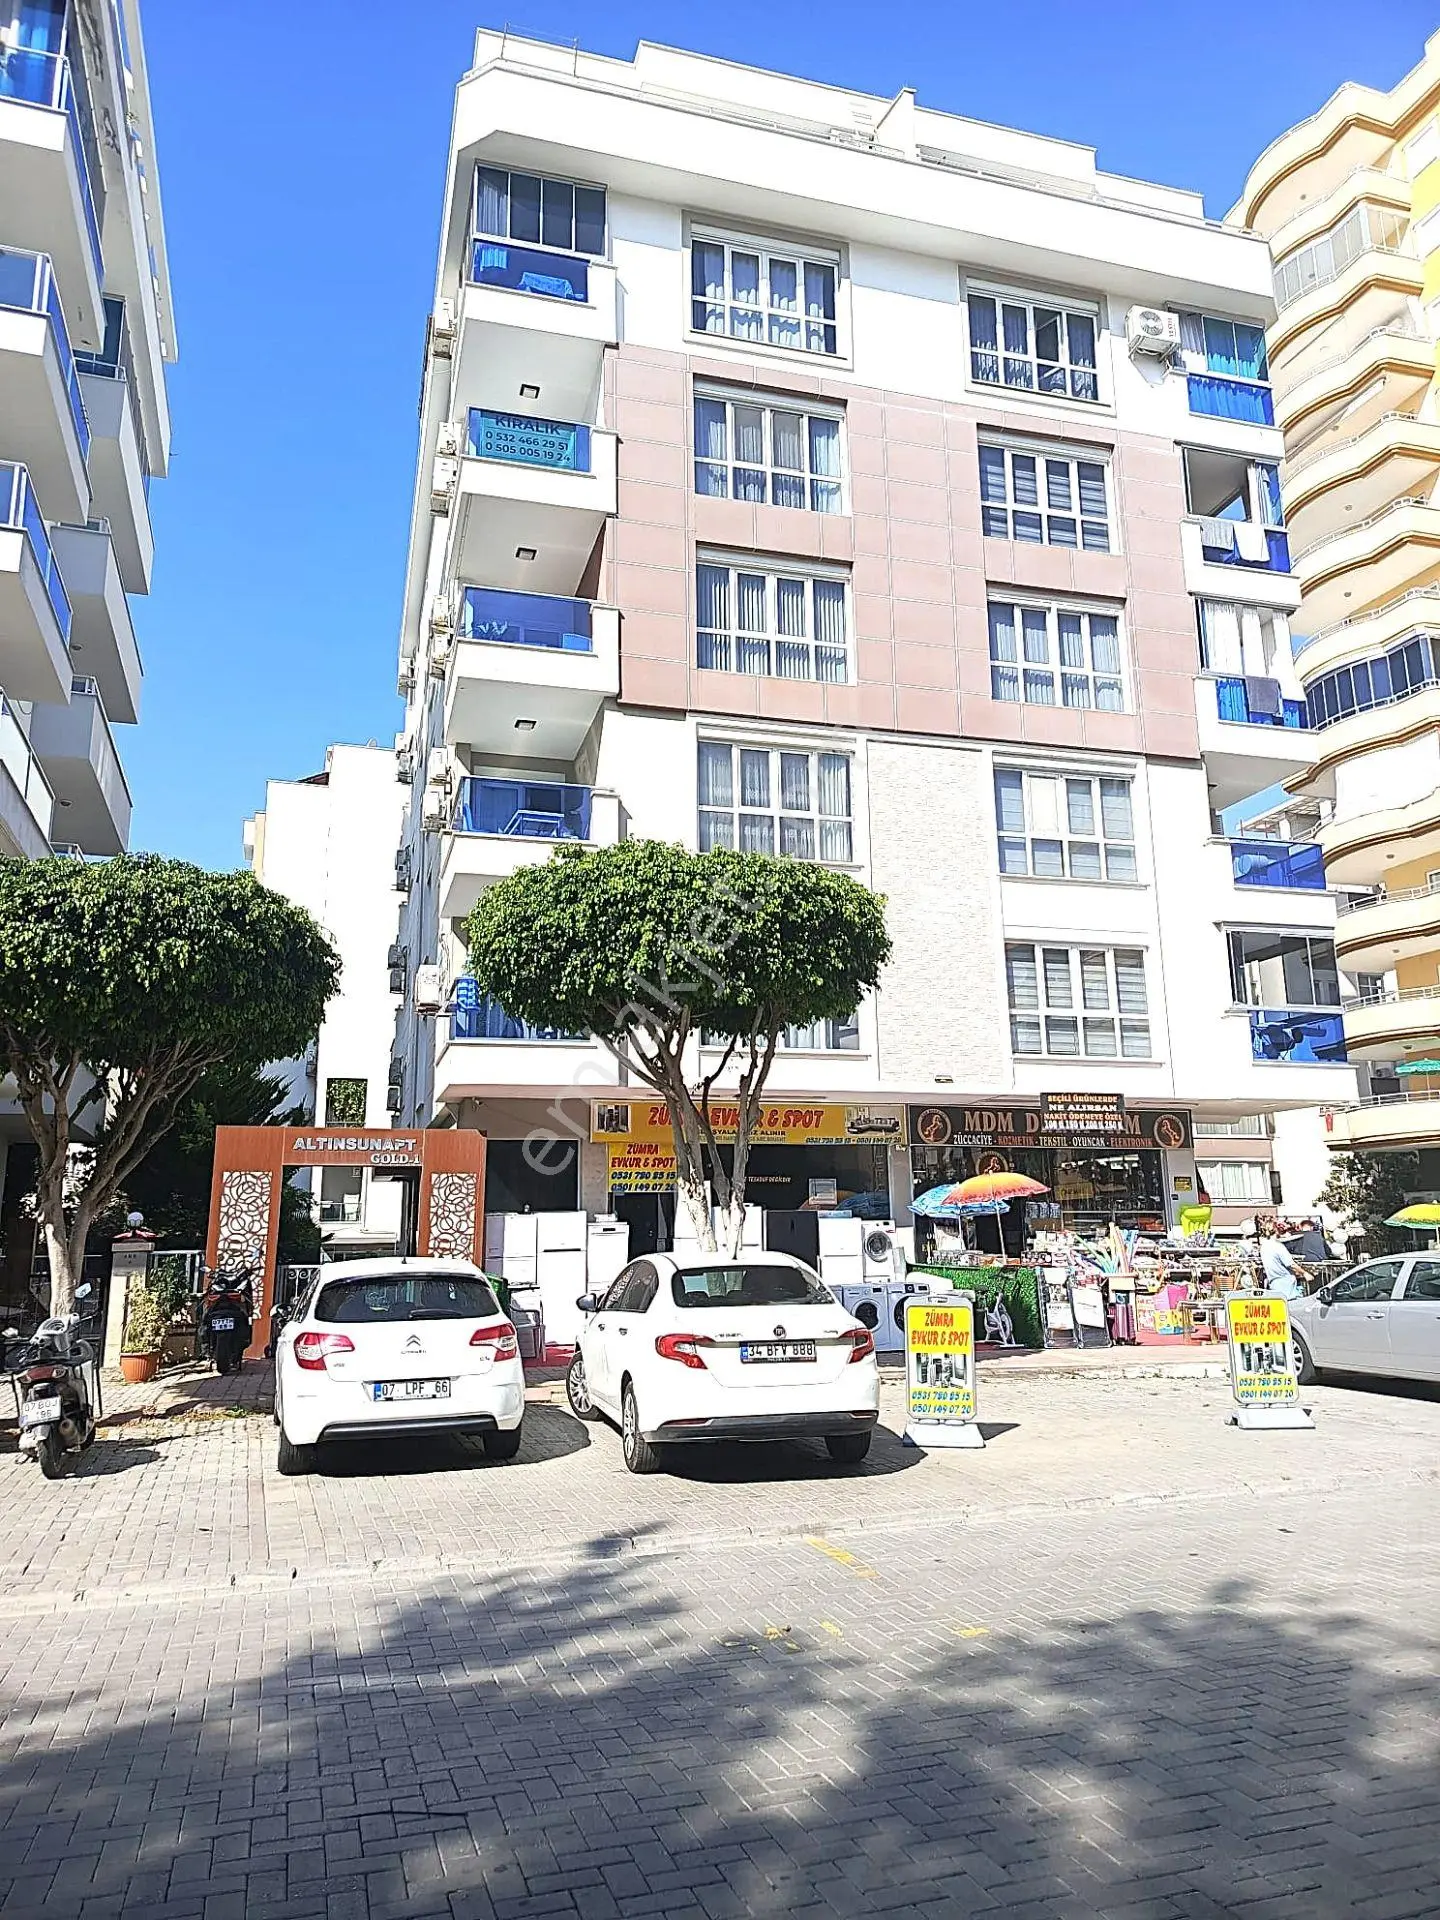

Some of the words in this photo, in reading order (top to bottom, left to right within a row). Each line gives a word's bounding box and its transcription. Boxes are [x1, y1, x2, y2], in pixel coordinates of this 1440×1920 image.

[496, 416, 562, 436] KIRALIK
[486, 430, 492, 439] 0
[496, 432, 515, 443] 532
[518, 436, 540, 446] 466
[542, 439, 556, 448] 29
[558, 441, 568, 450] 51
[486, 442, 492, 450] 0
[496, 443, 517, 454] 505
[520, 447, 540, 458] 005
[543, 450, 554, 460] 19
[557, 453, 571, 462] 24
[767, 1109, 778, 1127] &
[782, 1109, 824, 1128] SPOT
[964, 1110, 1014, 1132] MDM
[627, 1143, 659, 1154] ZÜMRA
[1072, 1136, 1105, 1147] OYUNCAK
[611, 1157, 641, 1168] EVKUR
[643, 1158, 649, 1167] &
[651, 1157, 675, 1168] SPOT
[1245, 1302, 1270, 1318] ZÜMRA
[925, 1309, 954, 1327] ZÜMRA
[1235, 1322, 1258, 1336] EVKUR
[1267, 1322, 1286, 1336] SPOT
[912, 1331, 938, 1346] EVKUR
[940, 1332, 946, 1345] &
[948, 1331, 969, 1346] SPOT
[749, 1344, 762, 1357] 34
[382, 1384, 395, 1396] 07
[406, 1382, 425, 1395] LPF
[435, 1381, 448, 1393] 66
